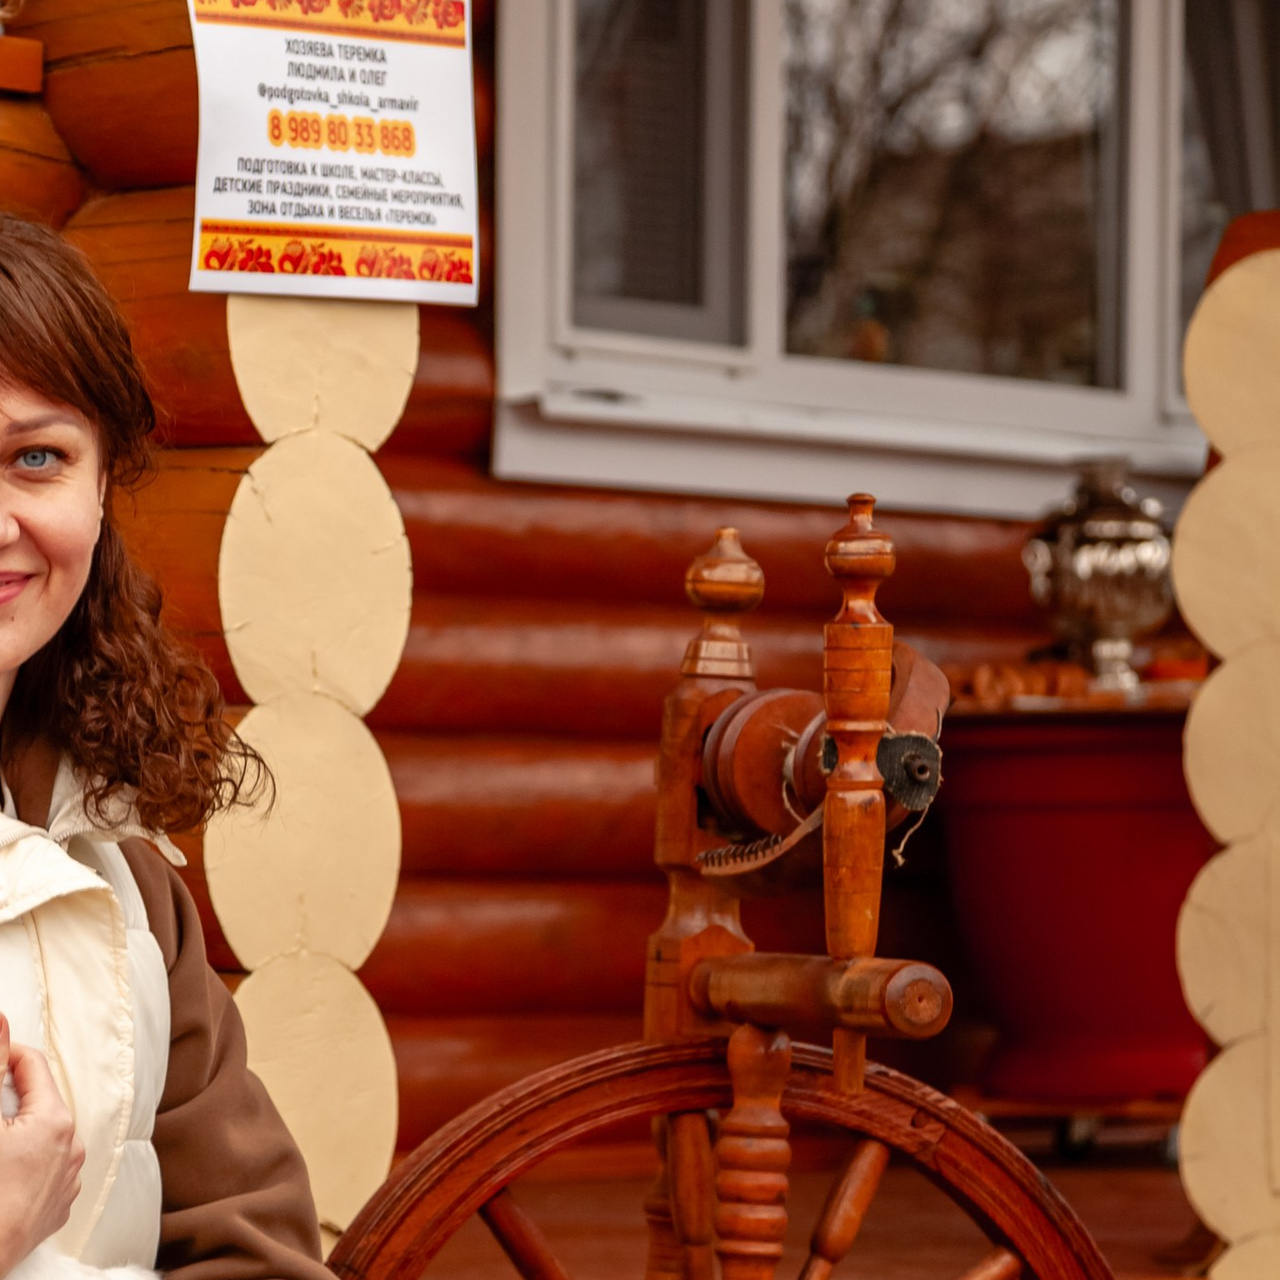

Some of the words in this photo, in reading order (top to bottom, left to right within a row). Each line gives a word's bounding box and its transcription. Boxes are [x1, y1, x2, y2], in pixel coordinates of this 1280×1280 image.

[285, 38, 334, 58] ХОЗЯЕВА
[337, 44, 387, 63] ТЕРЕМКА
[287, 61, 345, 81] ЛЮДМИЛА
[348, 68, 356, 83] И
[359, 69, 387, 86] ОЛЕГ
[257, 82, 419, 112] @podgotovka_shkola_armavir
[271, 115, 282, 141] 8
[288, 116, 321, 143] 989
[327, 120, 348, 146] 80
[354, 123, 375, 149] 33
[381, 125, 412, 151] 868
[237, 157, 307, 175] ПОДГОТОВКА
[310, 163, 318, 176] К
[320, 163, 357, 181] ШКОЛЕ,
[213, 177, 262, 193] ДЕТСКИЕ
[266, 180, 332, 199] ПРАЗДНИКИ,
[335, 183, 388, 202] СЕМЕЙНЫЕ
[248, 200, 276, 215] ЗОНА
[280, 202, 324, 218] ОТДЫХА
[328, 205, 334, 218] И
[338, 205, 381, 222] ВЕСЕЛЬЯ
